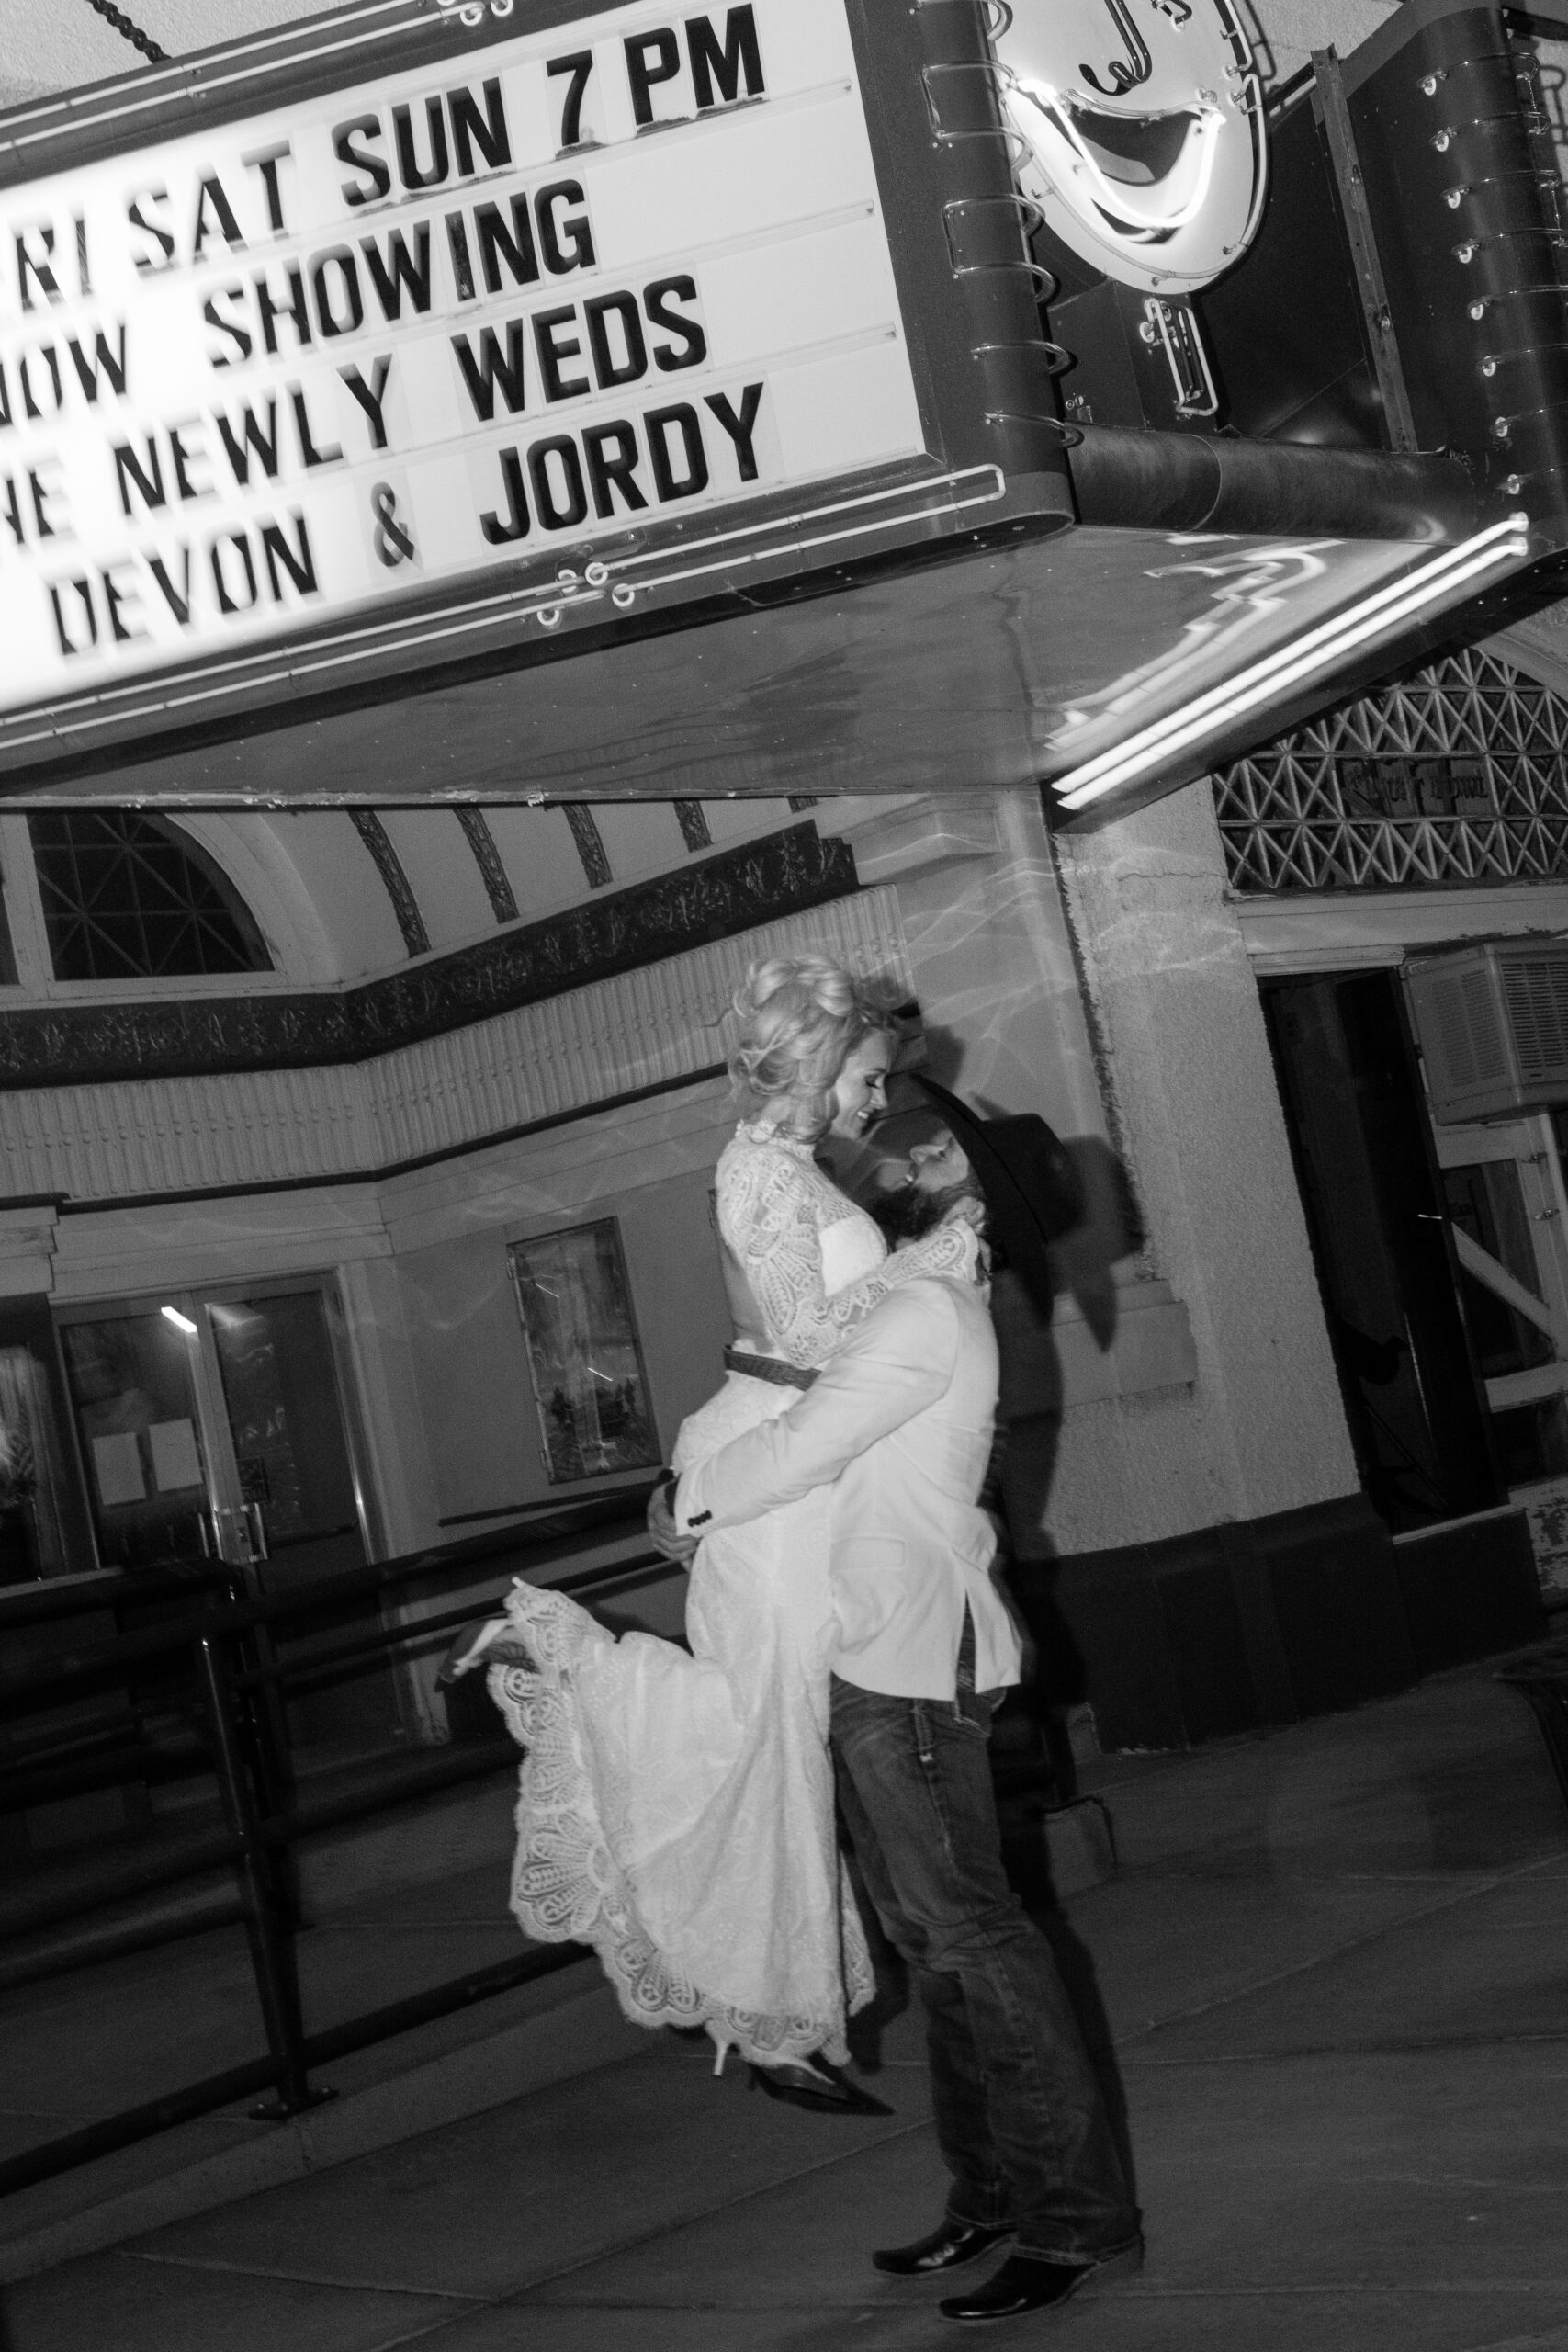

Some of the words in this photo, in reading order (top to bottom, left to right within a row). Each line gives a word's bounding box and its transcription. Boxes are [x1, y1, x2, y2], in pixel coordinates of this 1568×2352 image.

[0, 198, 93, 313] RI
[126, 138, 292, 278] SAT
[331, 77, 513, 208] SUN
[546, 50, 593, 146] 7
[623, 3, 766, 126] PM
[200, 178, 596, 369] SHOWING
[44, 504, 319, 657] DEVON
[370, 481, 414, 567] &
[479, 382, 764, 546] JORDY
[108, 353, 392, 517] NEWLY
[450, 274, 707, 422] WEDS
